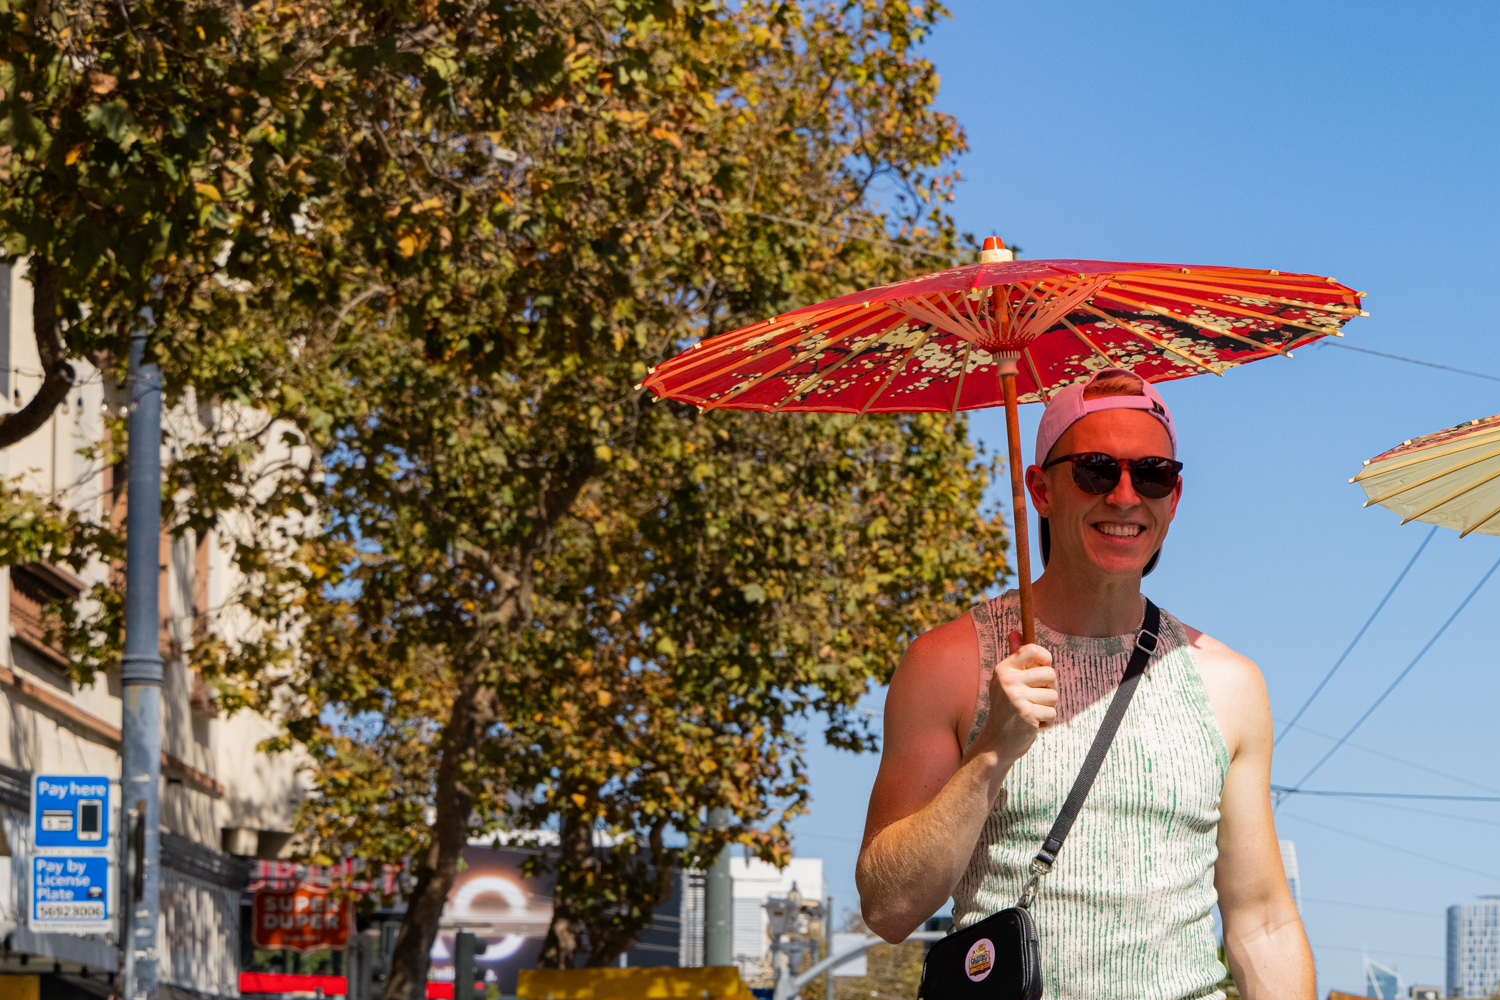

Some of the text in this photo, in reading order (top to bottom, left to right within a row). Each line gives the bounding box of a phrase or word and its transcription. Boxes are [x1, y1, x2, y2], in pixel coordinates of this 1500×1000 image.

[39, 781, 106, 799] Pay here
[36, 858, 87, 876] Pay by
[36, 874, 90, 887] License
[36, 888, 74, 900] Plate
[263, 914, 339, 929] DUPER
